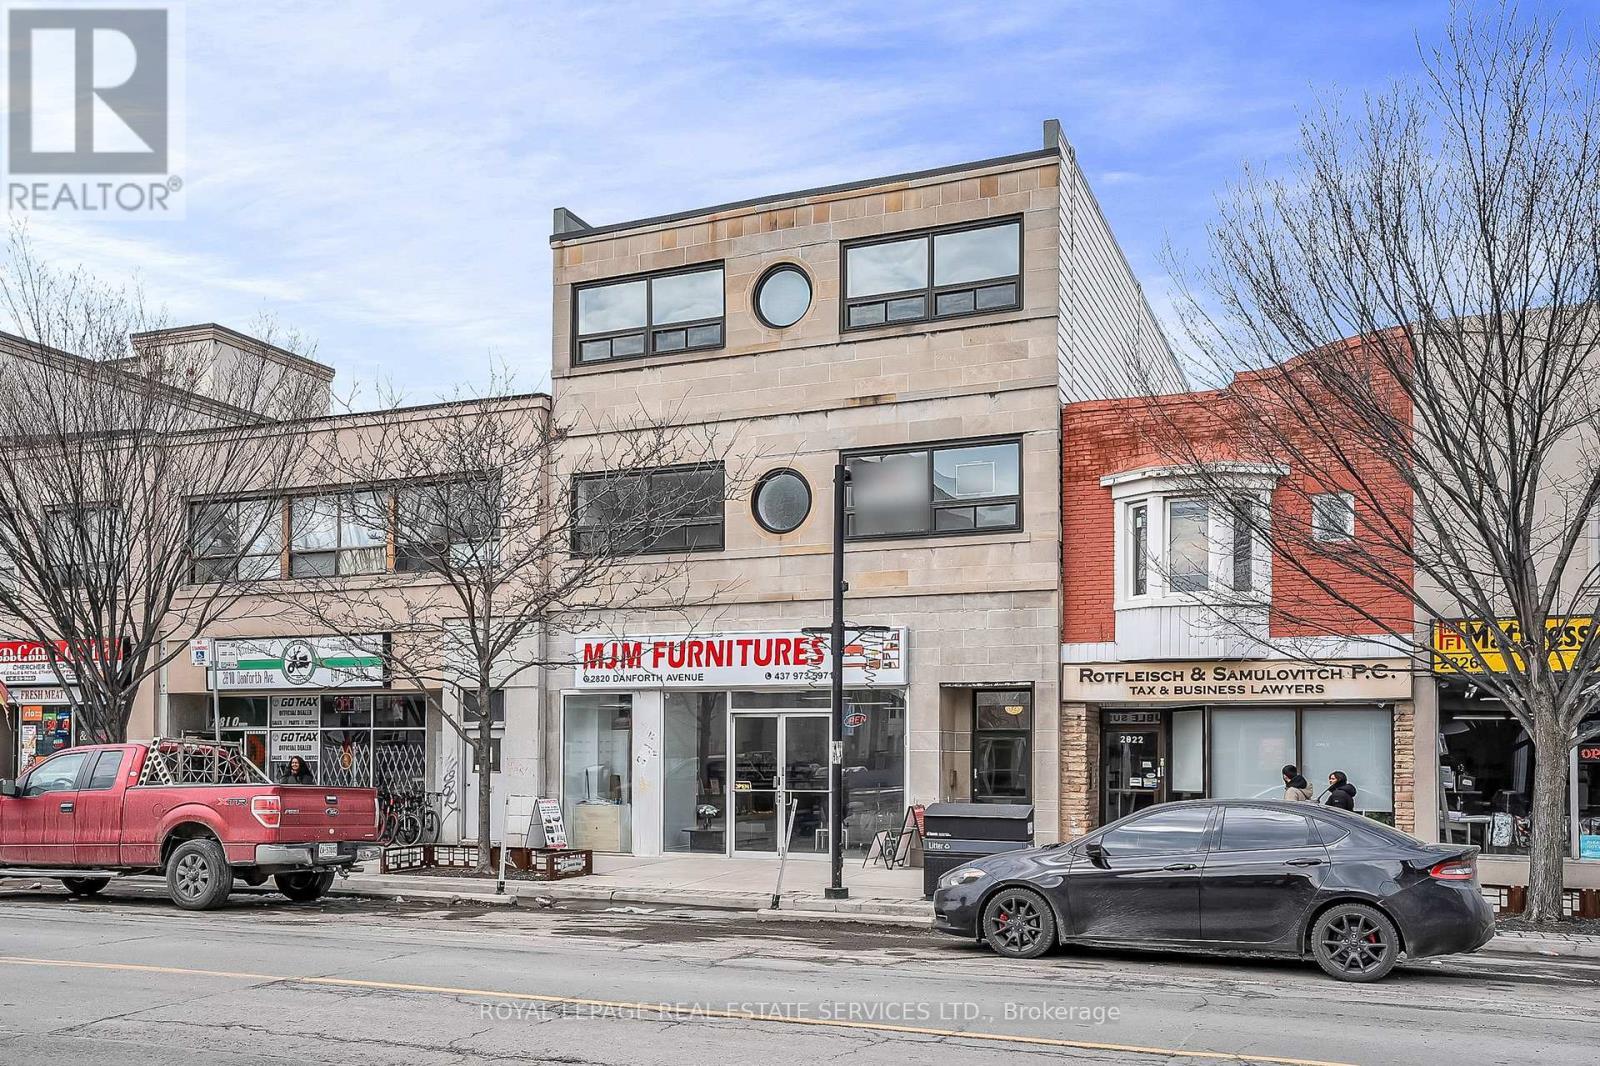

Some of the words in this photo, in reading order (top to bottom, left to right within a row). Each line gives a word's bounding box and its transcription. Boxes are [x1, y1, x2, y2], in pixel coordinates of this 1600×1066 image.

[582, 642, 642, 670] MJM
[652, 637, 825, 669] FURNITURES
[1440, 657, 1479, 670] 2826
[237, 671, 262, 684] Danforth
[263, 670, 275, 684] Ave.
[590, 674, 611, 683] 2820
[612, 673, 664, 683] DANFORTH
[666, 673, 704, 682] AVENUE
[774, 672, 790, 680] 437
[793, 672, 809, 680] 973
[1079, 667, 1185, 684] ROTFLEISCH
[1191, 667, 1206, 683] &
[1212, 665, 1343, 682] SAMULOVITCH
[1351, 663, 1397, 680] P.C.
[21, 690, 43, 699] FRESH
[45, 690, 64, 699] MEAT
[1129, 686, 1157, 696] TAX
[1160, 686, 1169, 695] &
[1174, 685, 1246, 696] BUSINESS
[1250, 684, 1325, 694] LAWYERS
[928, 842, 944, 850] Litter
